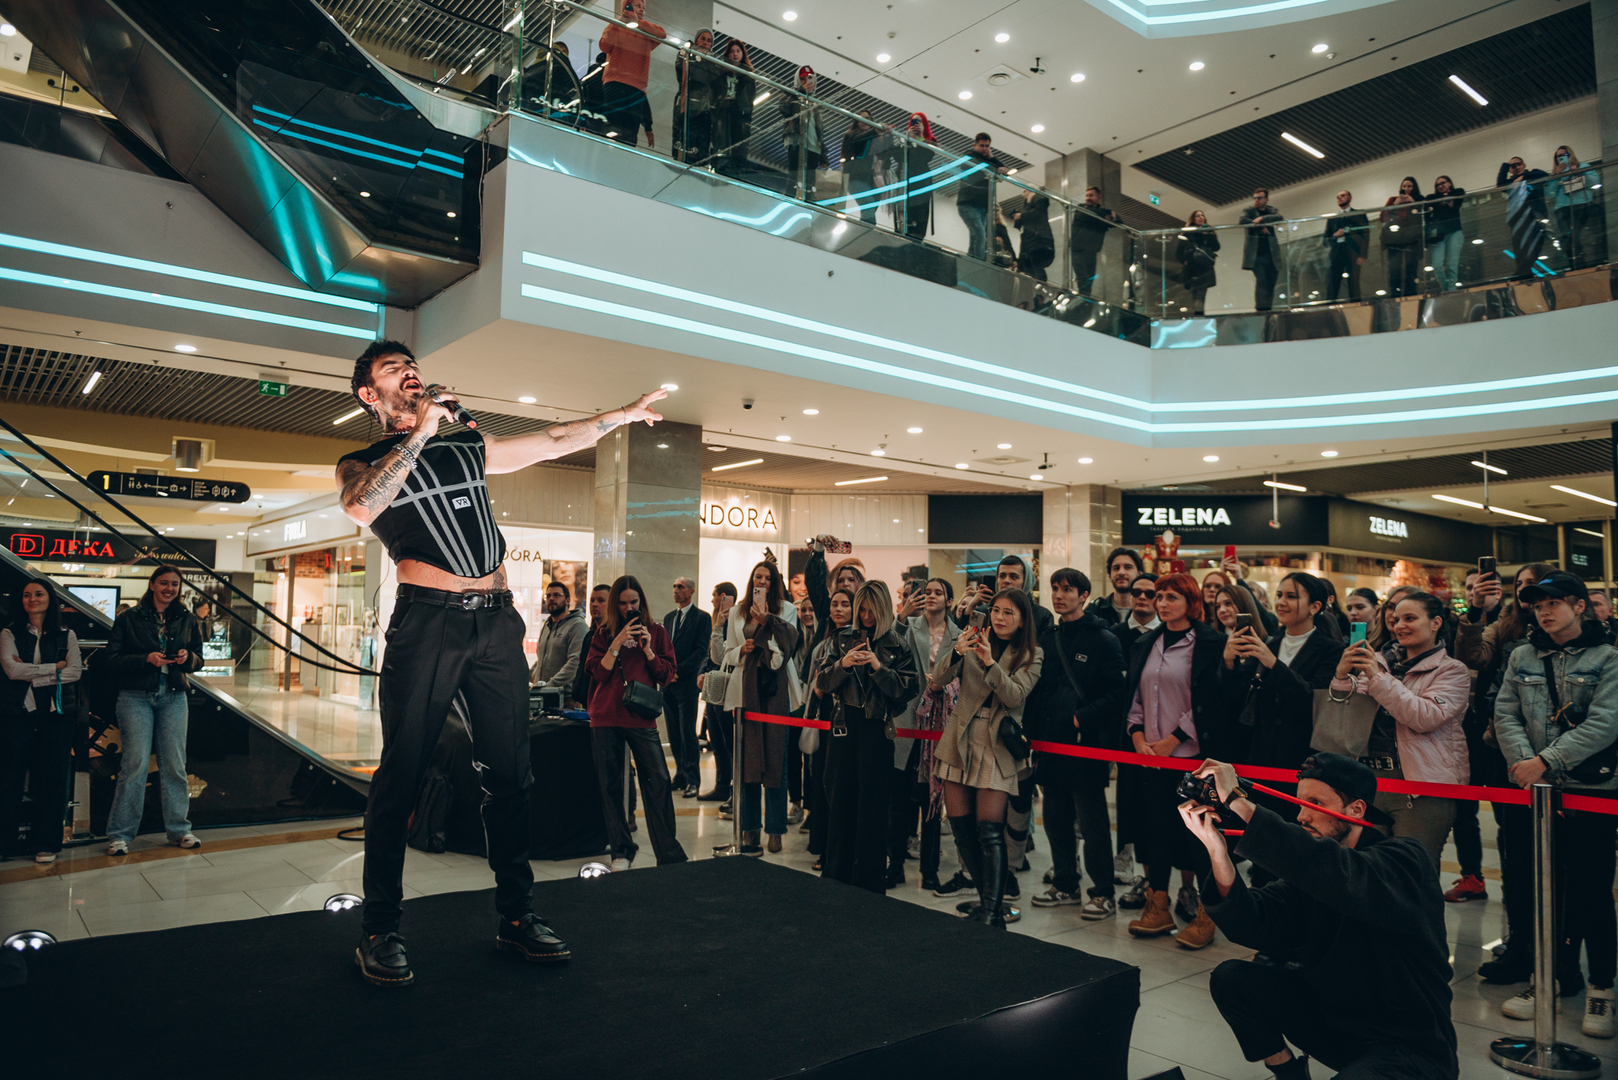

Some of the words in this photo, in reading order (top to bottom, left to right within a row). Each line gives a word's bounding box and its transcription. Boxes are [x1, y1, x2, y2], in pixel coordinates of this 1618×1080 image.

[102, 474, 110, 490] 1
[1137, 507, 1232, 526] ZELENA
[1369, 516, 1409, 538] ZELENA
[49, 539, 115, 558] ДЕКА
